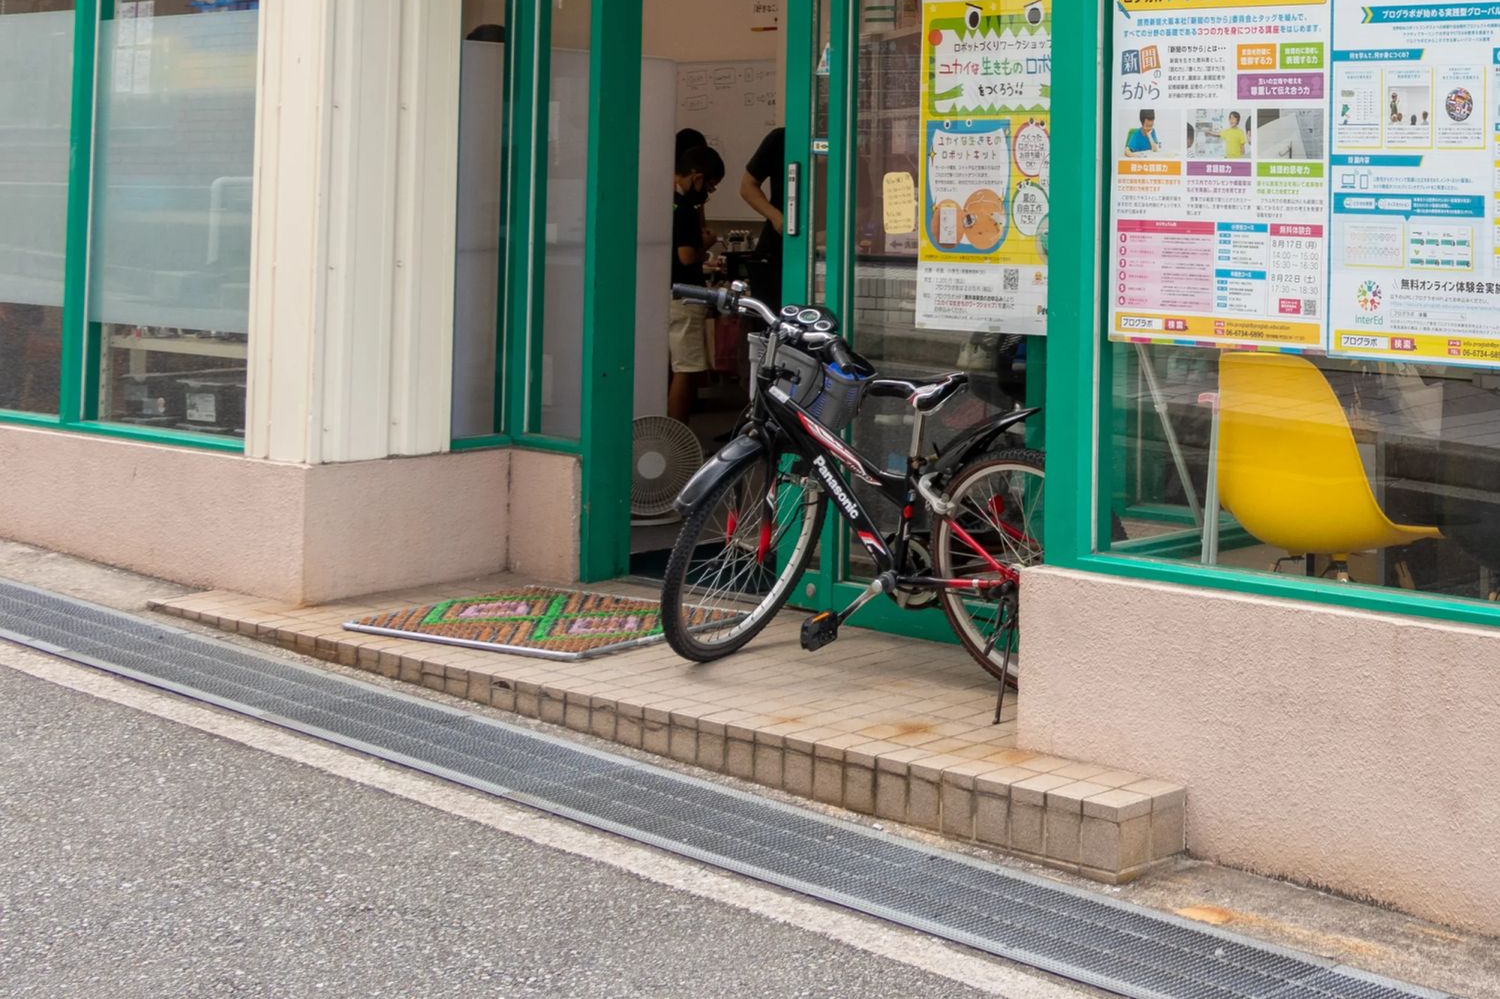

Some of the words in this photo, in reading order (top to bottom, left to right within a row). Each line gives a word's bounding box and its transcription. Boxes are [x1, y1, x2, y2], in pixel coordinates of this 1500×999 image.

[1026, 54, 1051, 75] ロボ
[1121, 81, 1160, 101] ちから
[938, 135, 1002, 146] ユカイな生きもの
[941, 150, 997, 160] ロボットキット
[1122, 317, 1153, 328] プログラボ
[1343, 336, 1378, 347] プログラボ
[1394, 339, 1412, 349] 検索
[813, 454, 860, 520] Panasonic
